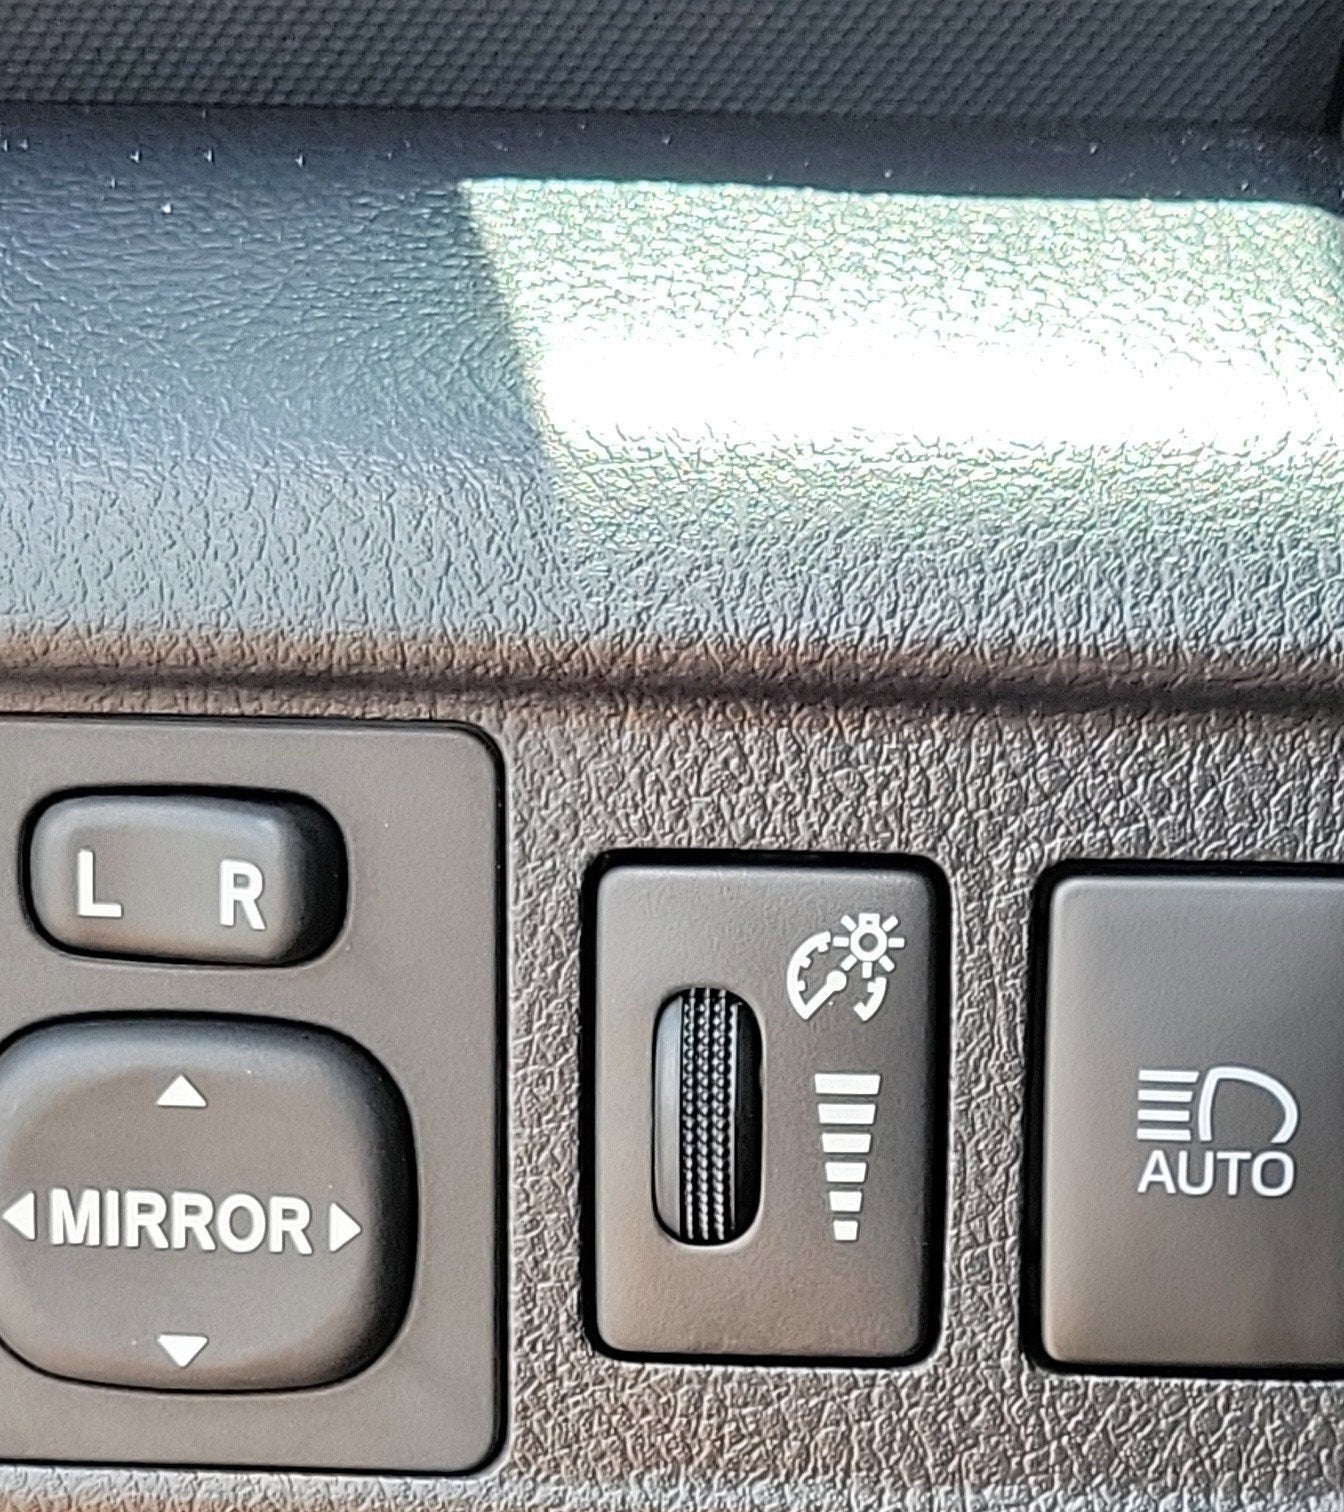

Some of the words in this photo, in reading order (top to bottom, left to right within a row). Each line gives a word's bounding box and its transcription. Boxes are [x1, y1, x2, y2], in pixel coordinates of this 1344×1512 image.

[77, 849, 123, 918] L
[219, 859, 266, 930] R
[1137, 1149, 1295, 1198] AUTO
[50, 1188, 312, 1255] MIRROR
